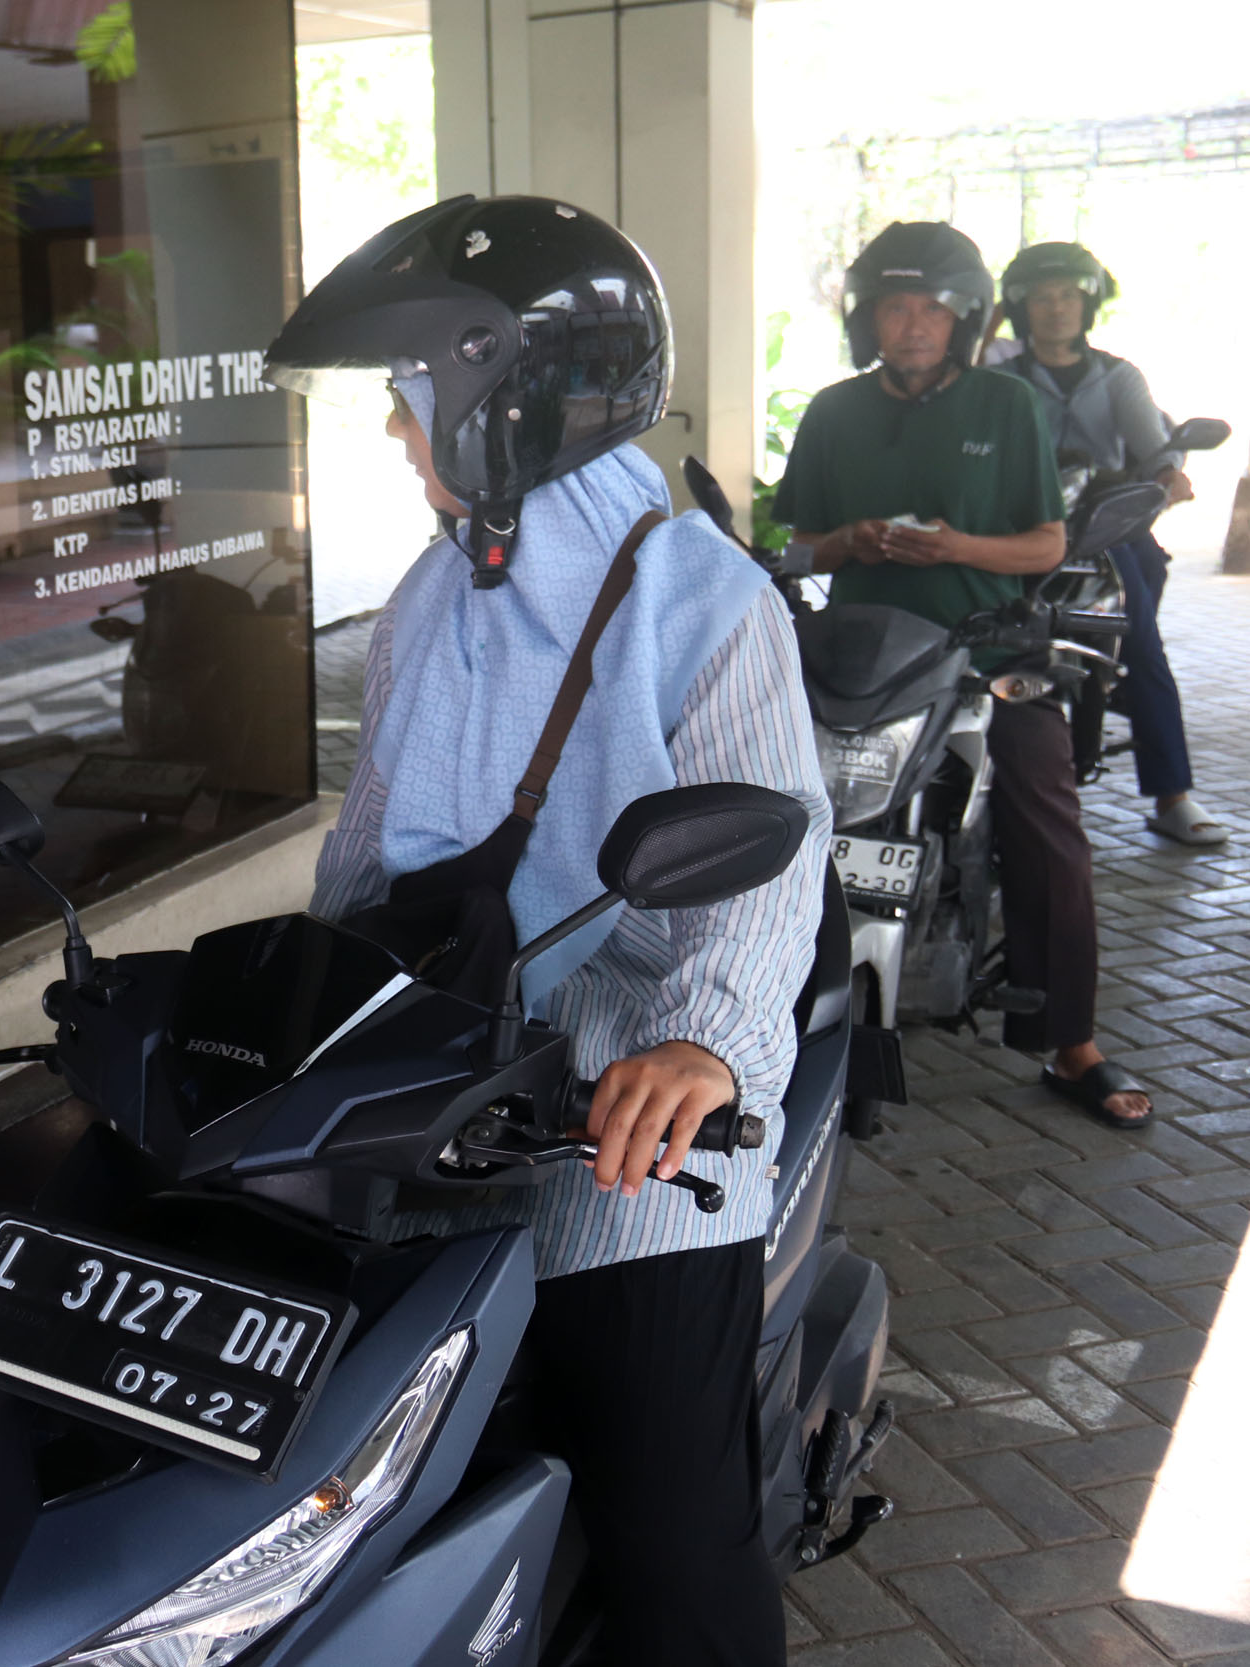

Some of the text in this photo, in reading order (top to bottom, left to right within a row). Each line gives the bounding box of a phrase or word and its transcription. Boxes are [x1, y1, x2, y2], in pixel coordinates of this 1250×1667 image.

[24, 362, 134, 421] SAMSAT
[141, 355, 213, 406] DRIVE
[27, 411, 171, 456] PRSYARATAN
[30, 460, 46, 480] 1.
[101, 446, 137, 470] ASLI
[32, 501, 48, 522] 2.
[52, 484, 138, 518] IDENTITAS
[141, 478, 172, 500] DIRI
[35, 530, 265, 599] 3. KENDARAAN HARUS DIBAWA
[53, 533, 89, 558] KTP
[185, 1039, 266, 1067] HONDA
[61, 1259, 203, 1341] 3127
[219, 1307, 306, 1377] DH
[476, 1617, 525, 1667] ONDA
